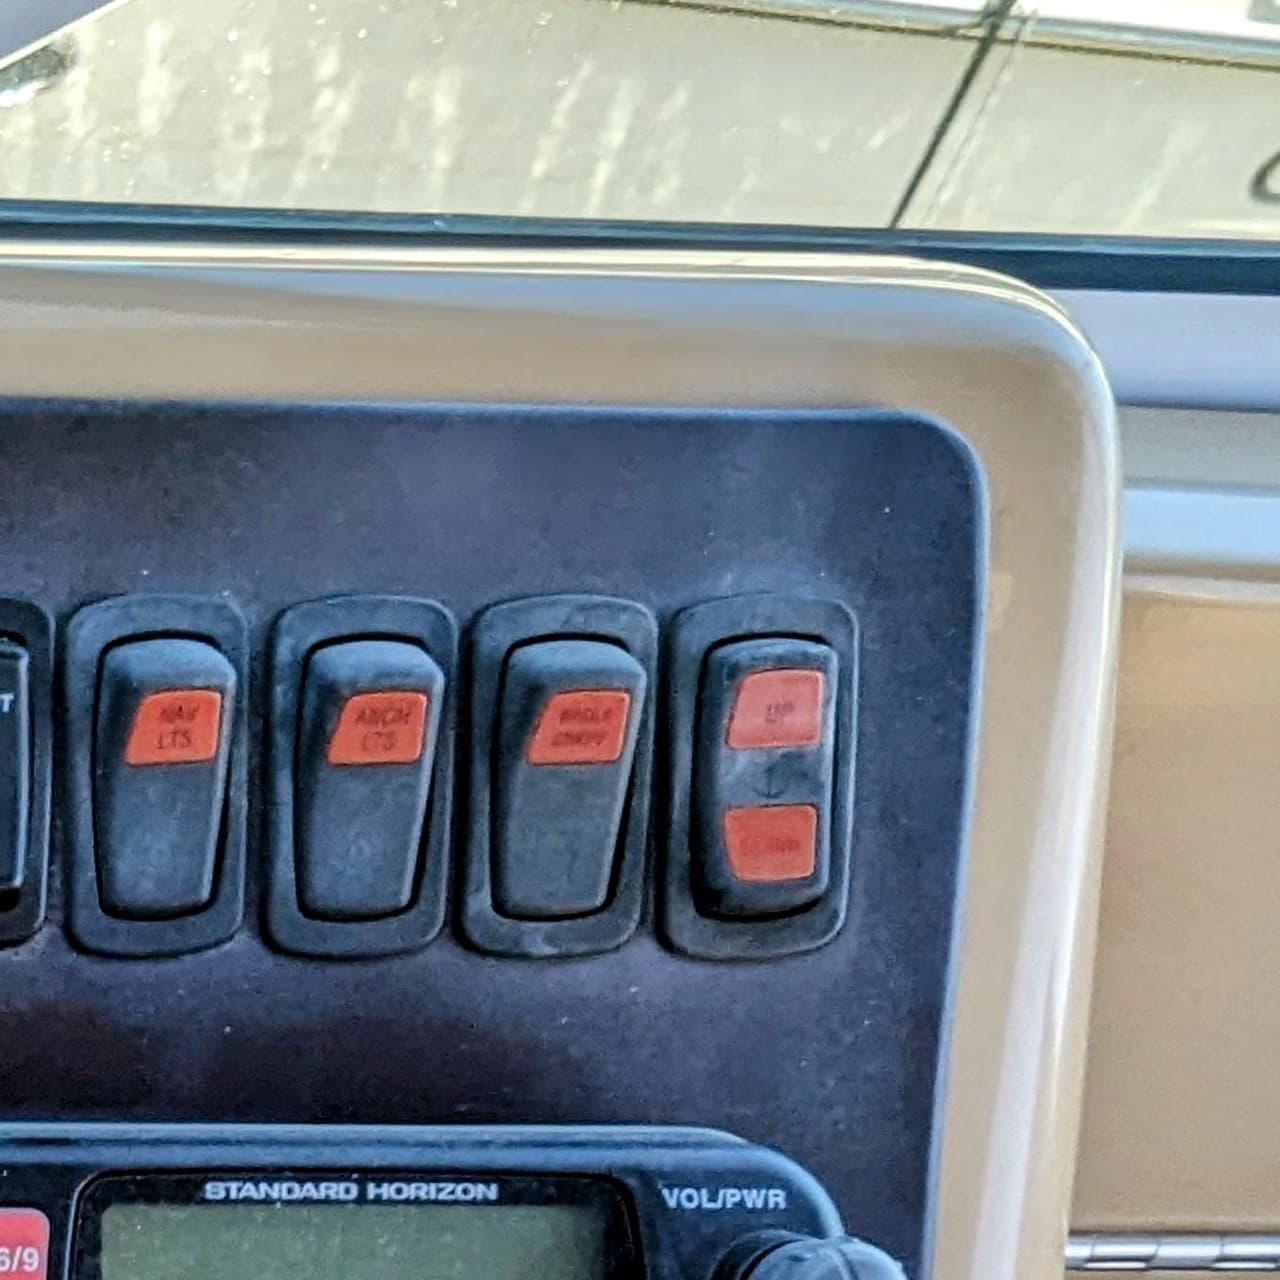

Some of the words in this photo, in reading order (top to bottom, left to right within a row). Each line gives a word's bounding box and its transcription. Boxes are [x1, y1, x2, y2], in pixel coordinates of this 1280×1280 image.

[157, 731, 191, 750] LTS
[204, 1181, 359, 1201] STANDARD
[366, 1181, 499, 1201] HORIZON
[662, 1187, 787, 1211] VOL/PWR
